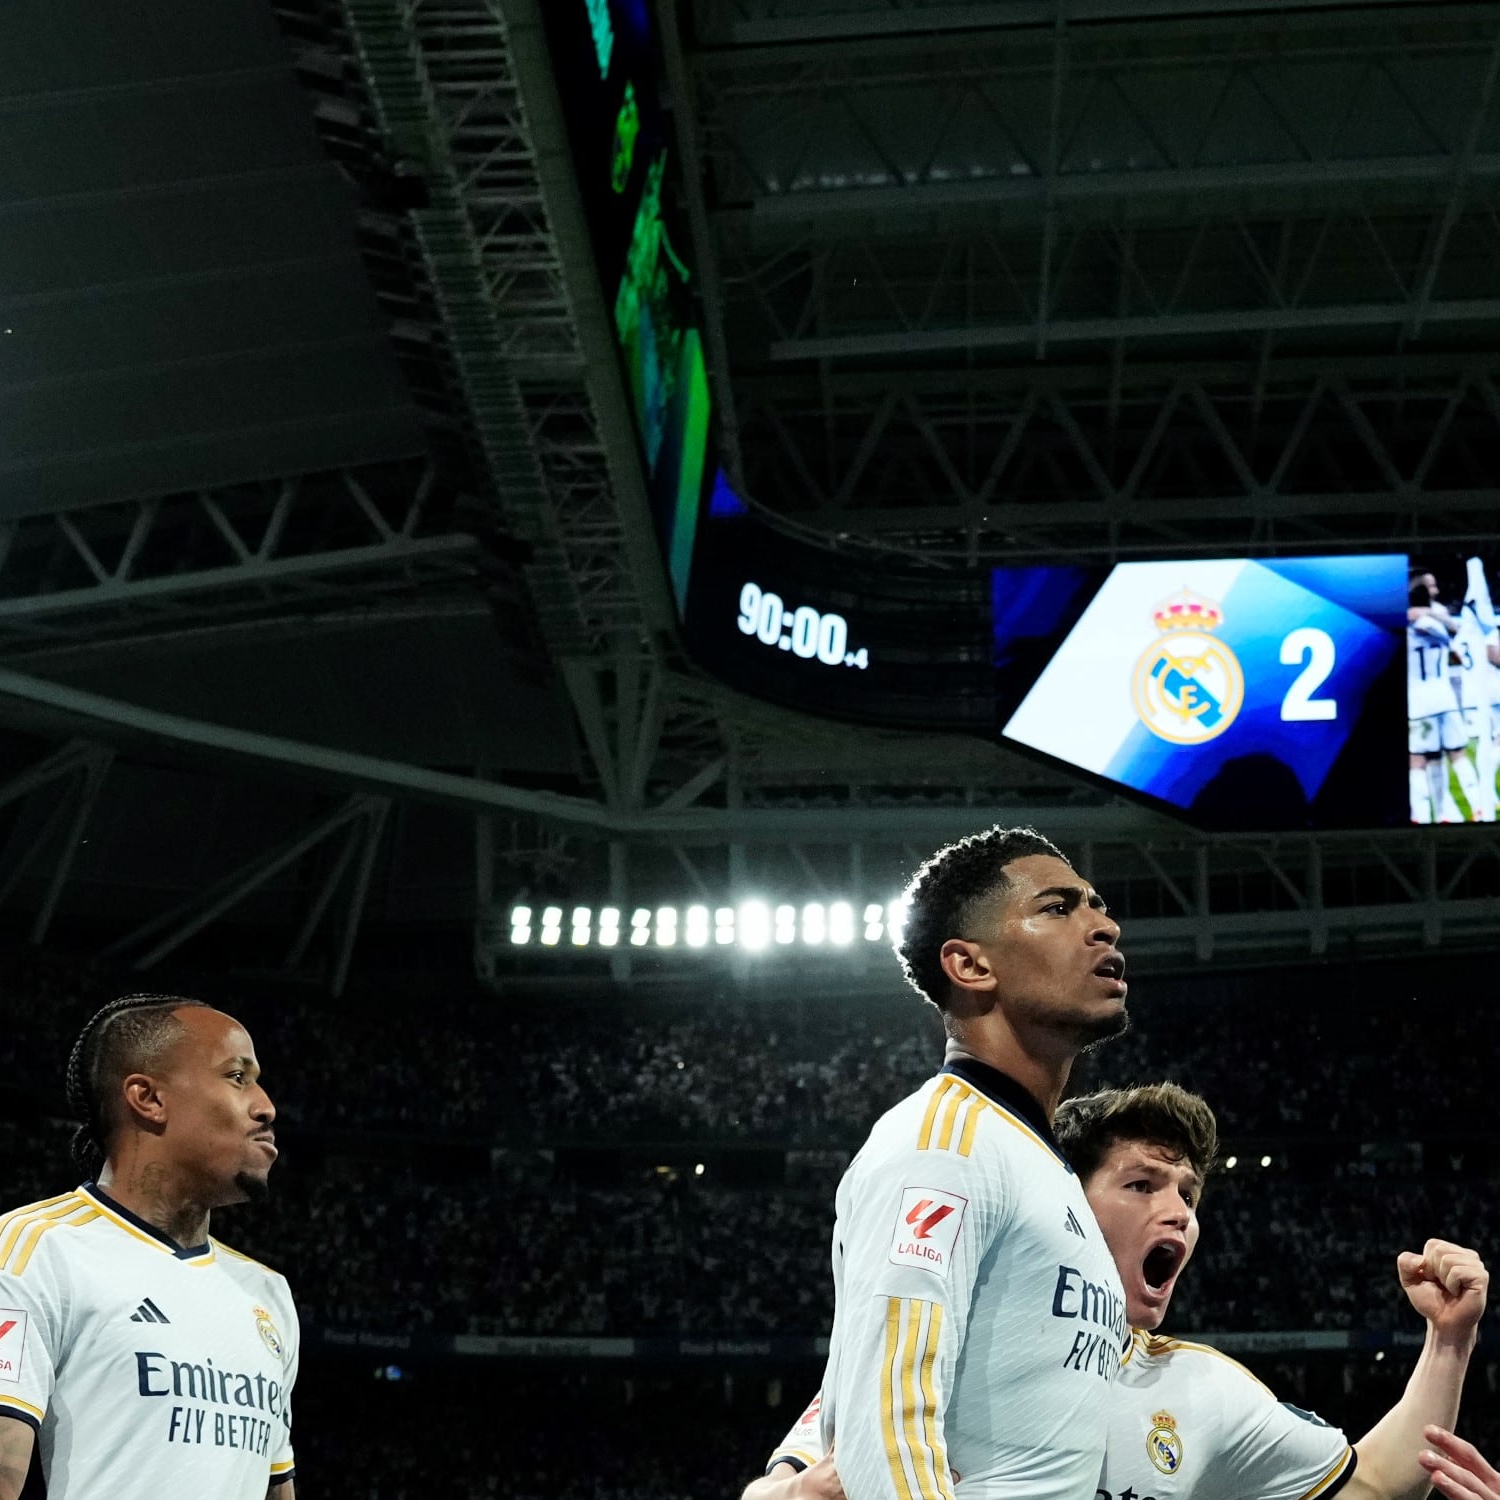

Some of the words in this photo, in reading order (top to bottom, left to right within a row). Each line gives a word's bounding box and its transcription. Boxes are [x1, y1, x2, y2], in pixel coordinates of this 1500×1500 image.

[737, 582, 848, 665] 90:00
[1279, 628, 1337, 721] 2
[898, 1243, 943, 1264] LALIGA
[1052, 1264, 1127, 1344] Emira
[134, 1351, 282, 1418] Emirates
[1063, 1331, 1099, 1371] FLY
[168, 1406, 205, 1444] FLY
[215, 1412, 271, 1458] BETTER
